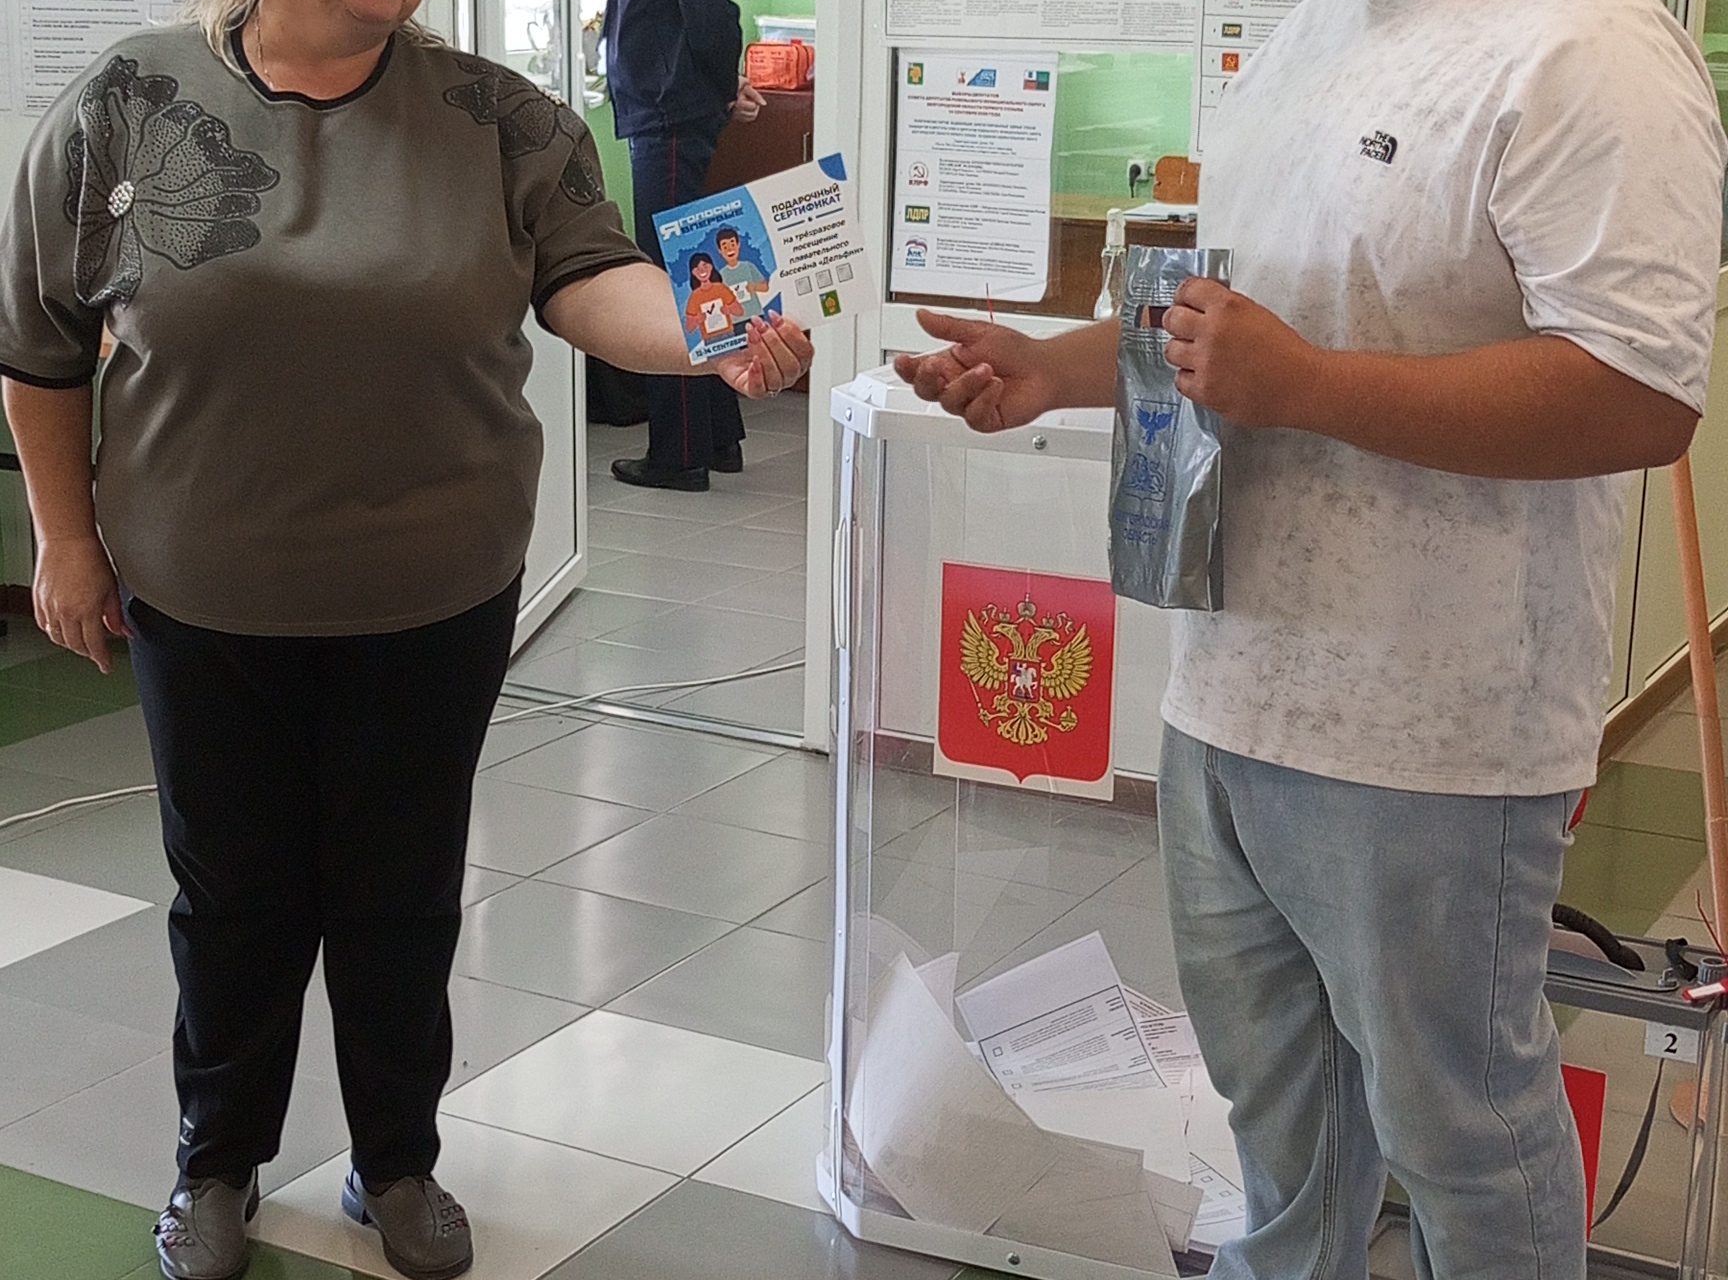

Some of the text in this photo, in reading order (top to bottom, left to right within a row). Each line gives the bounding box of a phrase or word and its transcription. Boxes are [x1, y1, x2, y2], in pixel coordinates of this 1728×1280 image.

[1375, 130, 1390, 143] THE
[908, 179, 929, 187] КПРФ
[771, 182, 840, 213] ПОДАРОЧНЫЙ
[773, 193, 842, 223] СЕРТИФИКАТ
[679, 199, 742, 226] ГОЛОСУЮ
[681, 208, 744, 234] ВПЕРВЫЕ
[906, 207, 929, 221] ЛДПР
[659, 220, 681, 240] Я
[782, 236, 794, 245] На
[789, 240, 850, 265] плавательного
[792, 232, 839, 253] посещение
[779, 261, 817, 278] бассейна
[1664, 1032, 1678, 1055] 2
